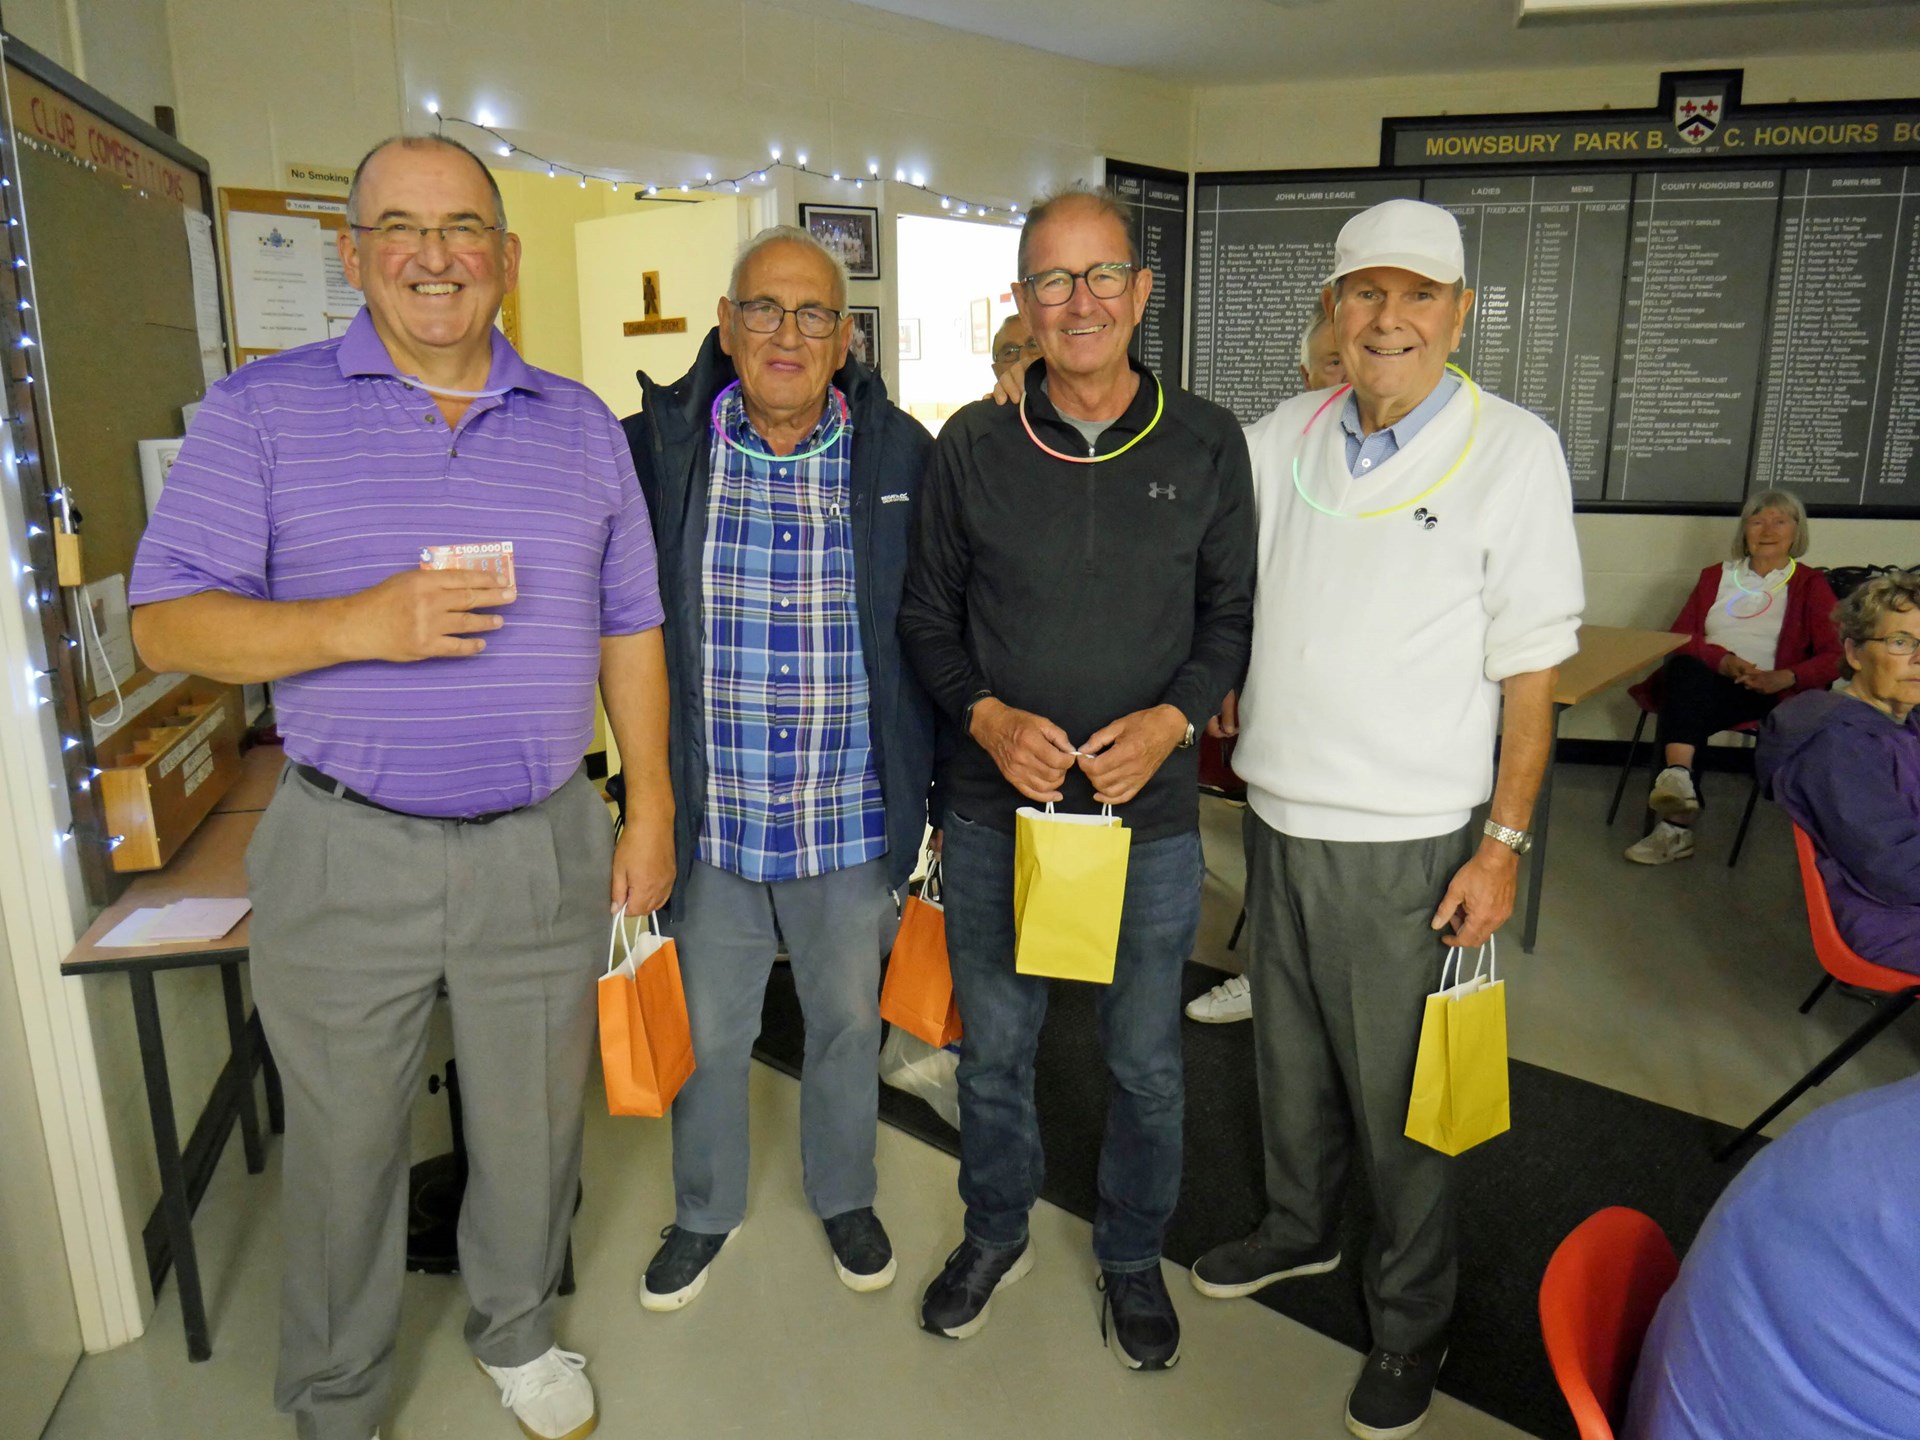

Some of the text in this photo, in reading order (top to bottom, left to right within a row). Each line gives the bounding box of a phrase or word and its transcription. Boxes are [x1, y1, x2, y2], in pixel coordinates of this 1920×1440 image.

[31, 97, 77, 150] CLUB
[1426, 134, 1561, 156] MOWSBURY
[1574, 131, 1639, 151] PARK
[1646, 131, 1668, 149] B.
[1724, 128, 1745, 147] C.
[1755, 123, 1879, 146] HONOURS
[1668, 146, 1702, 154] FOUNDED
[291, 169, 349, 185] No Smoking
[1571, 185, 1594, 193] MENS
[1661, 181, 1774, 191] COUNTY HONOURS BOARD
[1275, 191, 1356, 201] JOHN PLUMB LEAGUE
[1471, 187, 1501, 196] LADIES
[1486, 206, 1526, 214] FIXED JACK
[1585, 203, 1626, 212] FIXED JACK
